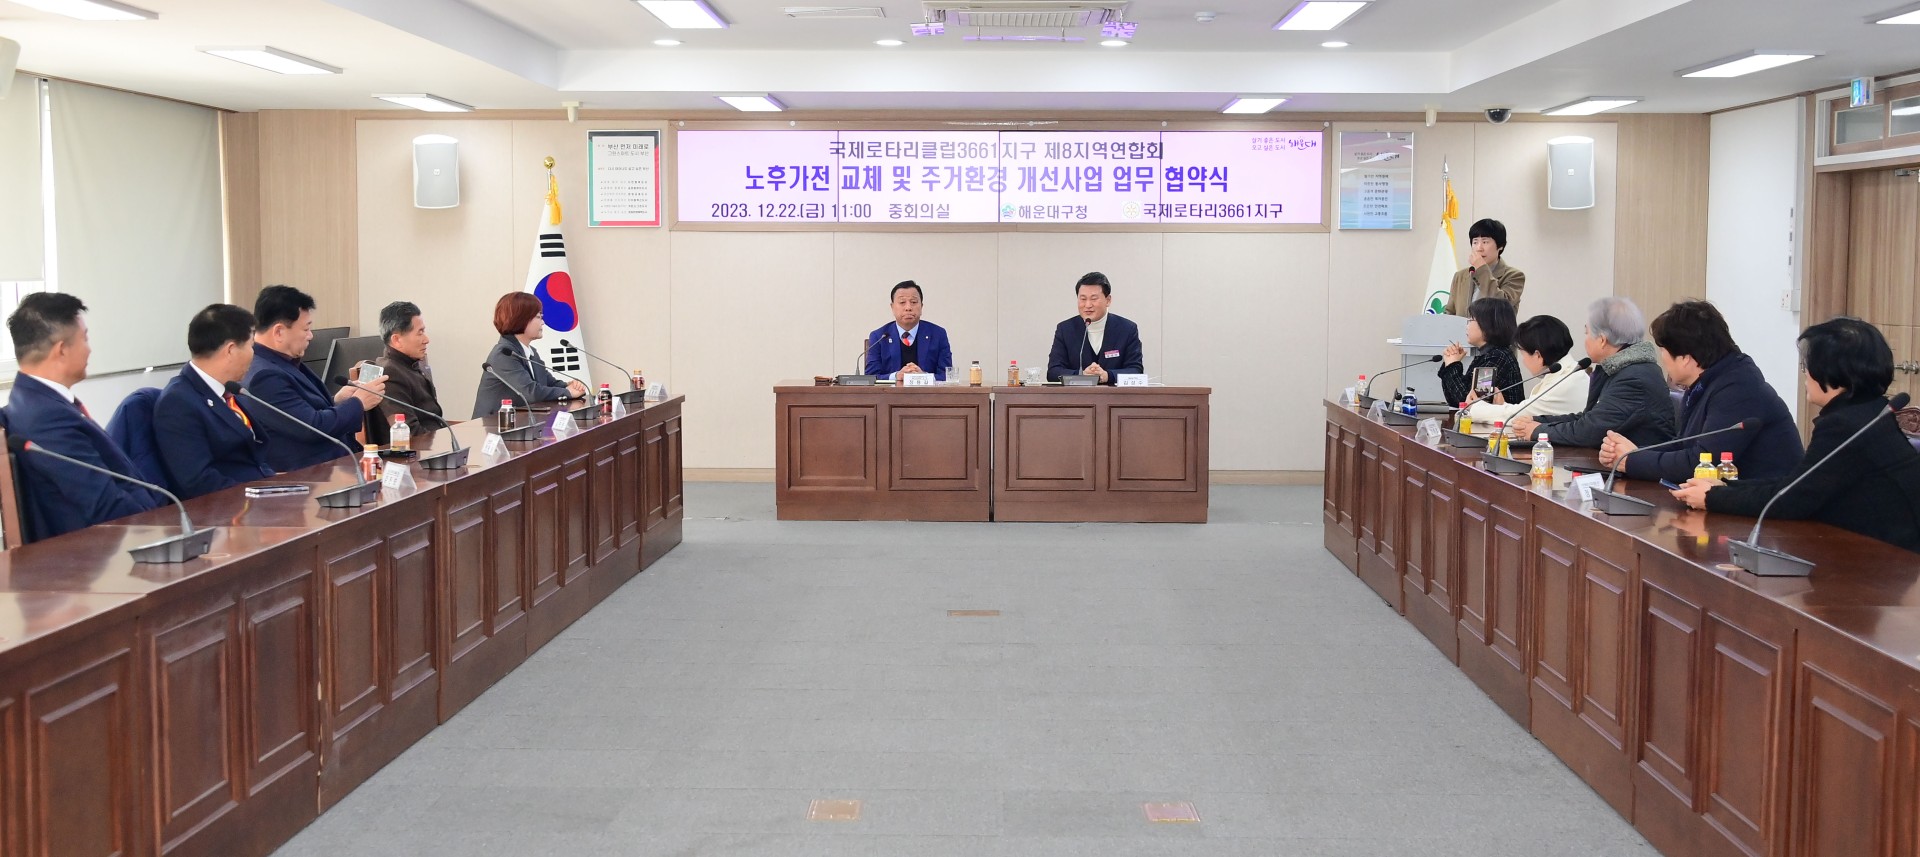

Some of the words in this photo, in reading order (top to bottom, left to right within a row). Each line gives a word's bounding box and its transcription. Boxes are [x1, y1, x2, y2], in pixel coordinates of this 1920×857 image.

[829, 141, 1036, 160] 국제로타리클럽3661지구
[1044, 141, 1165, 160] 제8지역연합회
[745, 165, 830, 192] 노후가전
[840, 165, 883, 192] 교체
[892, 165, 912, 192] 및
[921, 165, 1008, 193] 주거환경
[1017, 166, 1104, 193] 개선사업
[1112, 166, 1155, 193] 업무
[1164, 166, 1228, 193] 협약식
[711, 203, 752, 218] 2023.
[758, 203, 825, 219] 12.22.(금)
[831, 203, 872, 218] 11:00
[888, 203, 950, 219] 중회의실
[1018, 204, 1088, 220] 해운대구청
[1143, 203, 1284, 219] 국제로타리3661지구
